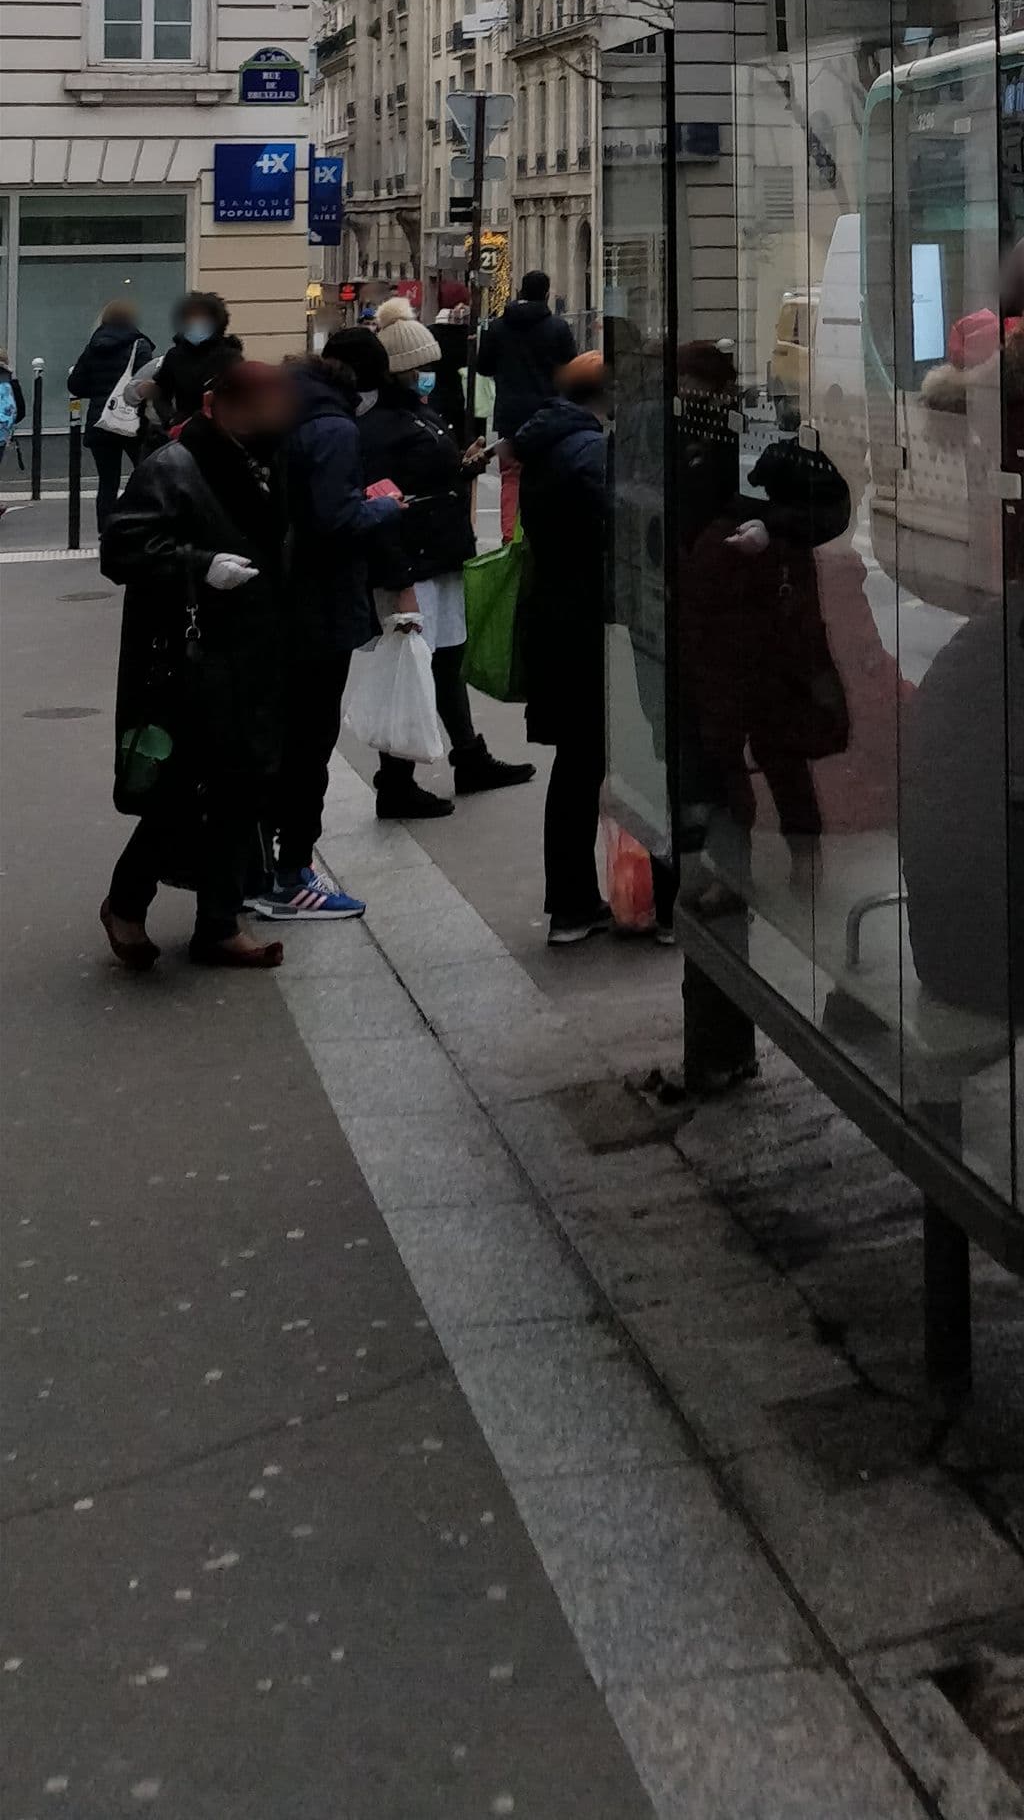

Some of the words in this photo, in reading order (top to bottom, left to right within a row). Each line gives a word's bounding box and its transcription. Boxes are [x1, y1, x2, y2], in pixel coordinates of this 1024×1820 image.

[262, 71, 281, 80] RUE
[265, 81, 278, 90] DE
[247, 91, 296, 100] BRUXELLES
[219, 198, 290, 207] BANQUE
[219, 208, 290, 218] POPULAIRE
